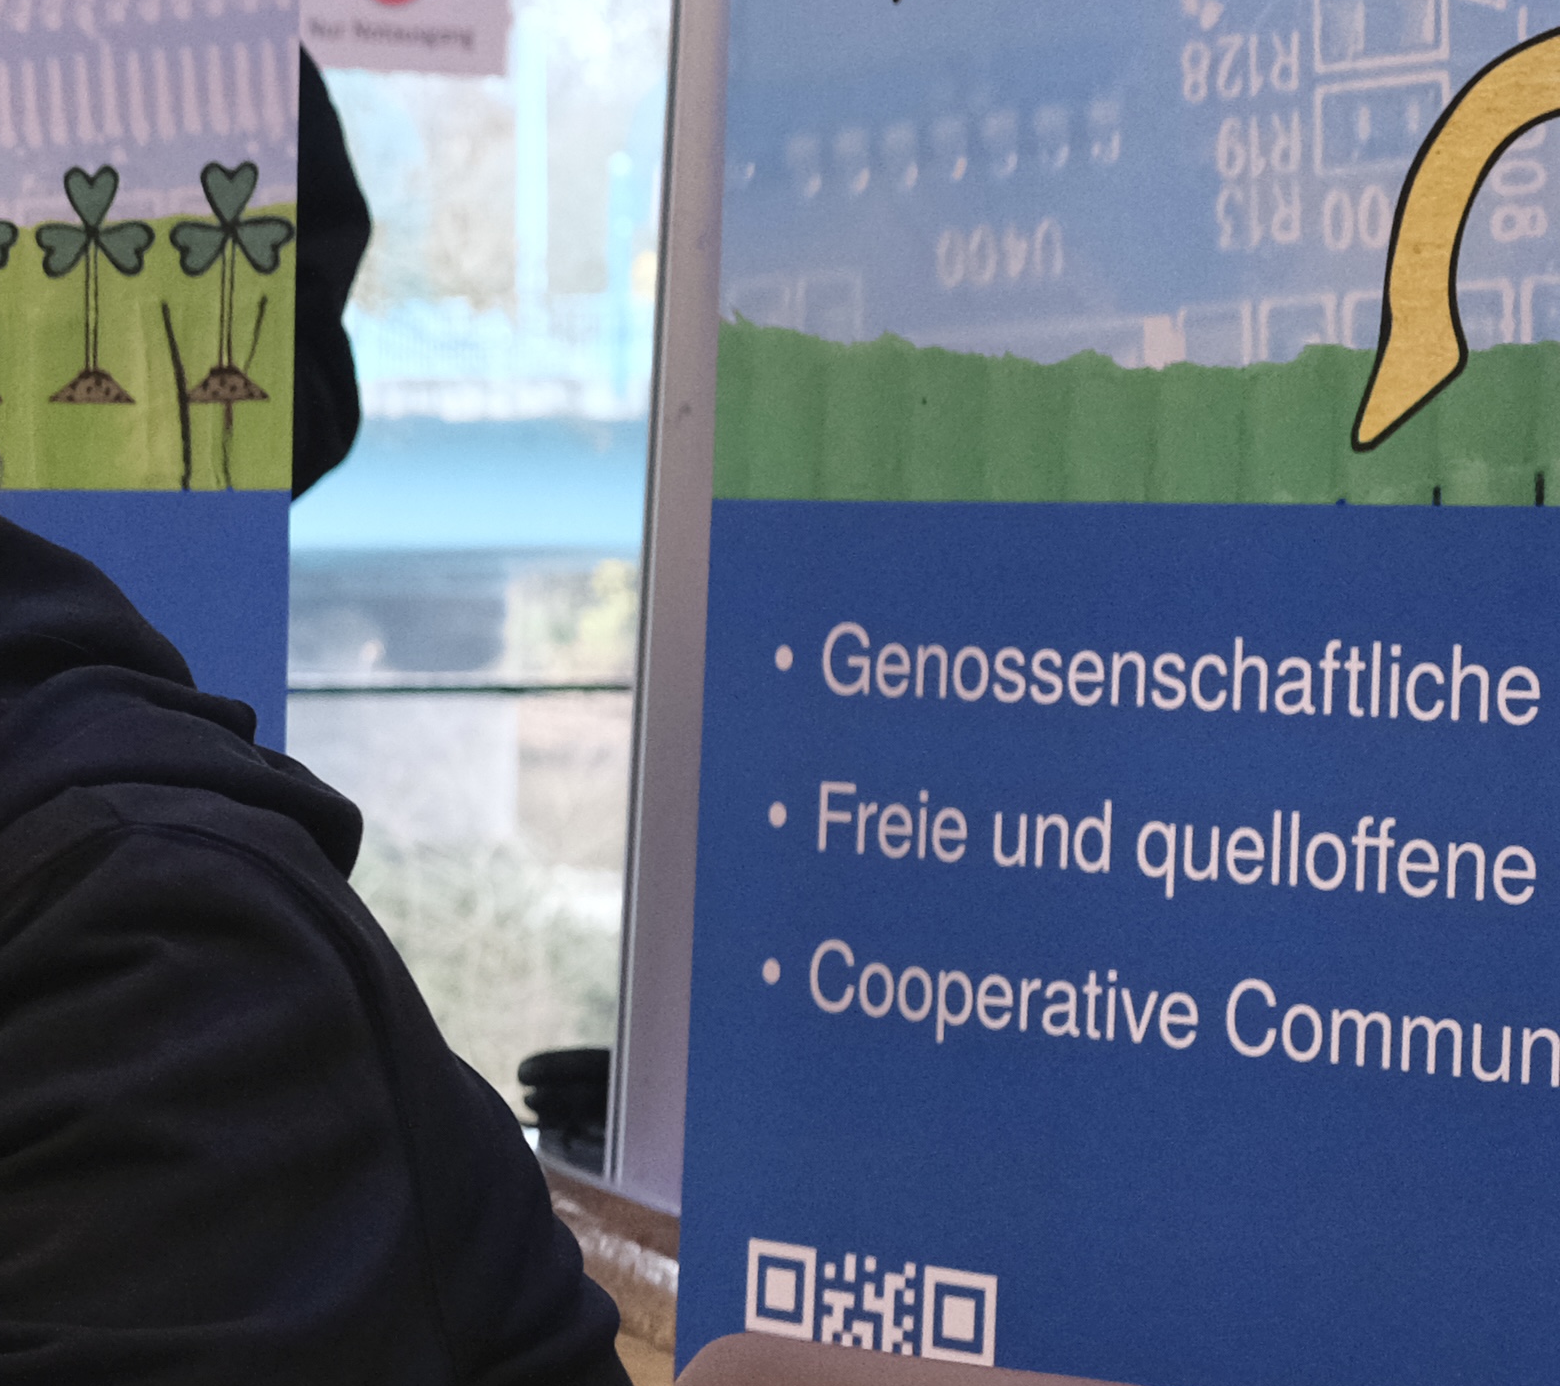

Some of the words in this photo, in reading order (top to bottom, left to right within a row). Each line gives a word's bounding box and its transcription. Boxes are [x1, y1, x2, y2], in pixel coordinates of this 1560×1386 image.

[821, 621, 1542, 727] Genossenschaftliche
[817, 780, 969, 864] Freie
[992, 798, 1114, 875] und
[1135, 808, 1538, 906] quelloffene
[808, 938, 1201, 1051] Cooperative
[1224, 977, 1560, 1089] Commun
